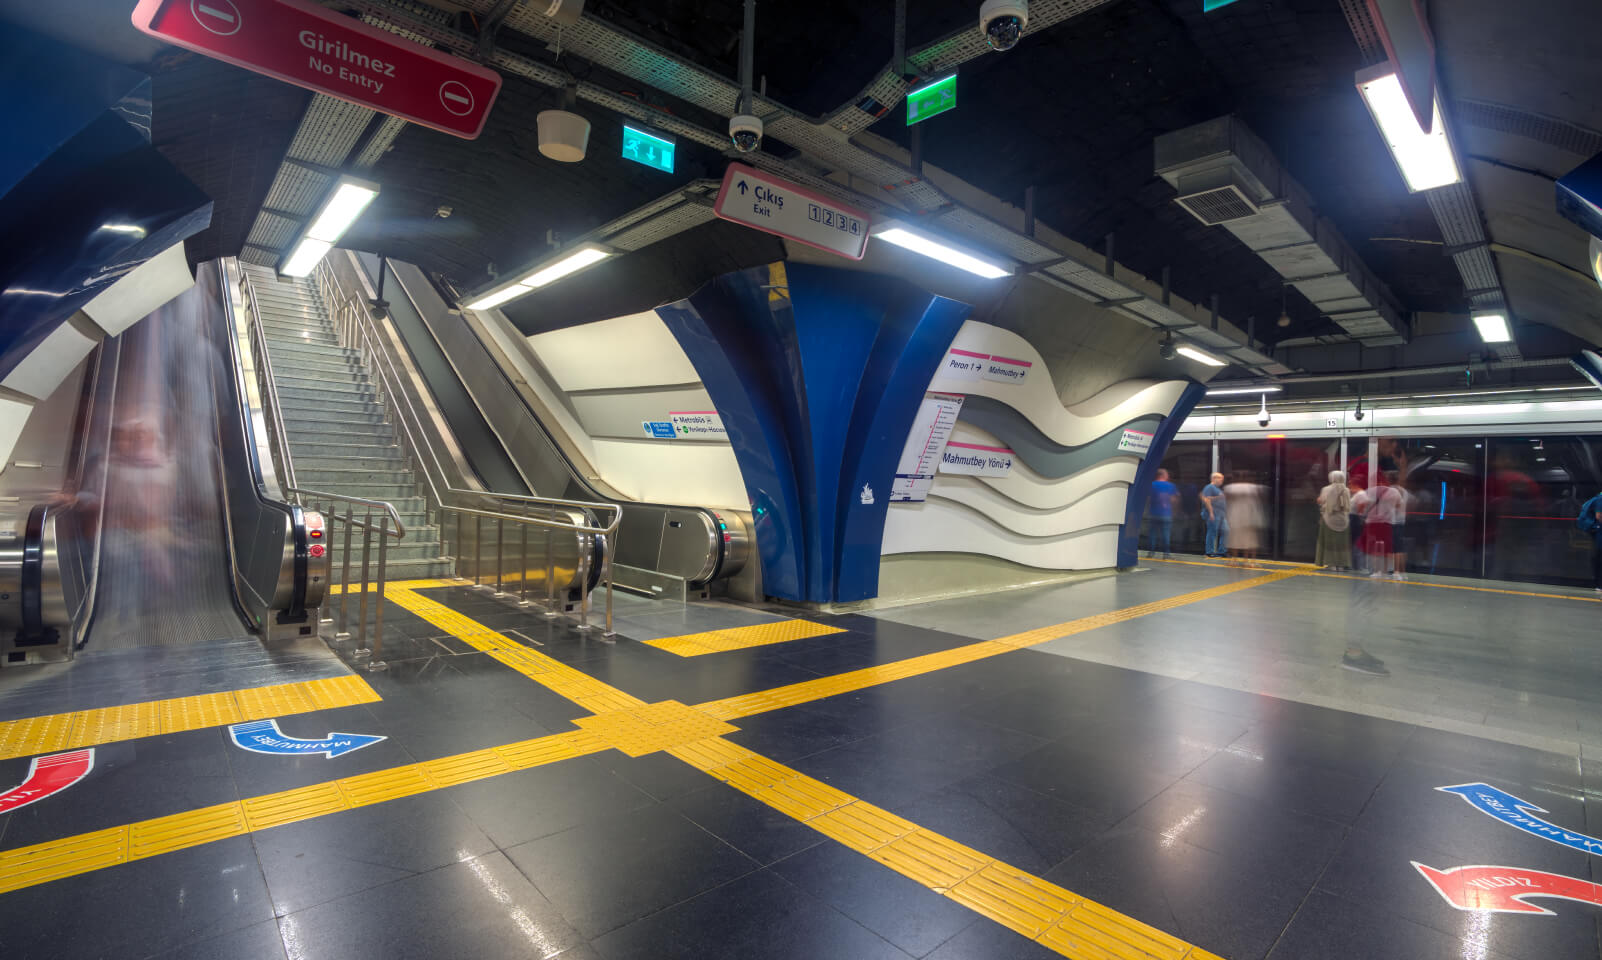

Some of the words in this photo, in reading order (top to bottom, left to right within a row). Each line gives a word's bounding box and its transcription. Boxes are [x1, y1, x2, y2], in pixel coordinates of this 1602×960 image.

[298, 30, 396, 78] Girilmez
[308, 56, 334, 75] No
[338, 67, 384, 94] Entry
[754, 186, 784, 210] Çıkış
[753, 204, 771, 217] Exit
[950, 359, 969, 371] Peron
[989, 366, 1019, 379] Mahmutbey
[942, 453, 987, 469] Mahmutbey
[987, 457, 1005, 469] Yönü
[1466, 876, 1542, 891] YILDIZ
